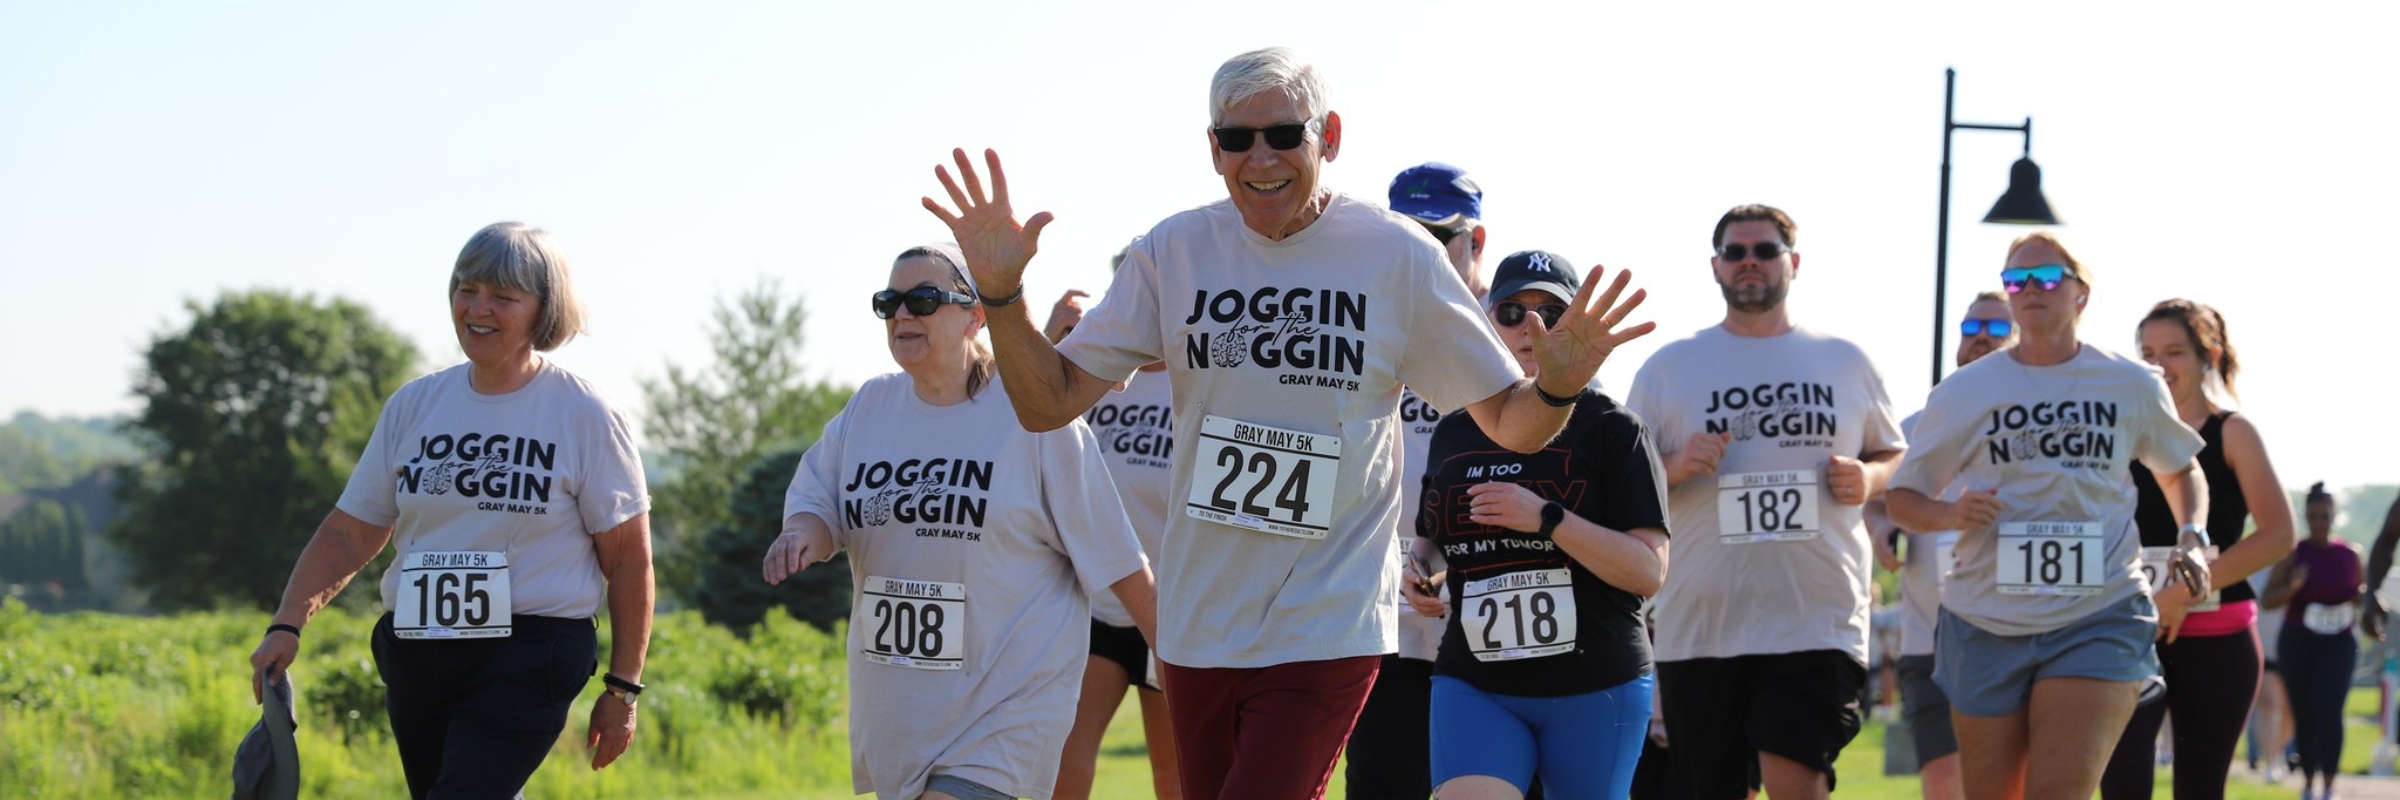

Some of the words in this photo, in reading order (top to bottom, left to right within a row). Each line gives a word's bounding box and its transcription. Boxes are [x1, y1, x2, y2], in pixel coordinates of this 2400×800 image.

[1186, 286, 1366, 331] JOGGIN
[1227, 315, 1270, 342] for
[1279, 374, 1314, 386] GRAY
[1316, 376, 1345, 389] MAY
[1347, 381, 1360, 392] 5K
[1706, 382, 1834, 413] JOGGIN
[1987, 400, 2117, 435] JOGGIN
[410, 433, 556, 471] JOGGIN
[1234, 424, 1264, 443] GRAY
[1267, 430, 1294, 448] MAY
[1296, 435, 1314, 451] 5K
[845, 458, 994, 492] JOGGIN
[1211, 446, 1311, 522] 224
[1466, 466, 1484, 478] IM
[1489, 463, 1522, 477] TOO
[1767, 473, 1785, 483] MAY
[478, 502, 504, 512] GRAY
[507, 504, 533, 514] MAY
[534, 506, 547, 515] 5K
[1737, 489, 1803, 532] 182
[942, 529, 965, 539] MAY
[966, 532, 981, 542] 5K
[1444, 543, 1469, 557] FOR
[1474, 539, 1497, 553] MY
[1500, 538, 1555, 551] TUMOR
[422, 554, 447, 567] GRAY
[450, 554, 470, 567] MAY
[473, 553, 488, 566] 5K
[2018, 540, 2084, 585] 181
[885, 580, 903, 594] GRAY
[906, 581, 927, 596] MAY
[929, 584, 942, 597] 5K
[1487, 578, 1508, 591] GRAY
[1511, 575, 1534, 587] MAY
[1536, 572, 1550, 585] 5K
[413, 573, 490, 627] 165
[874, 599, 944, 657] 208
[1478, 591, 1558, 650] 218
